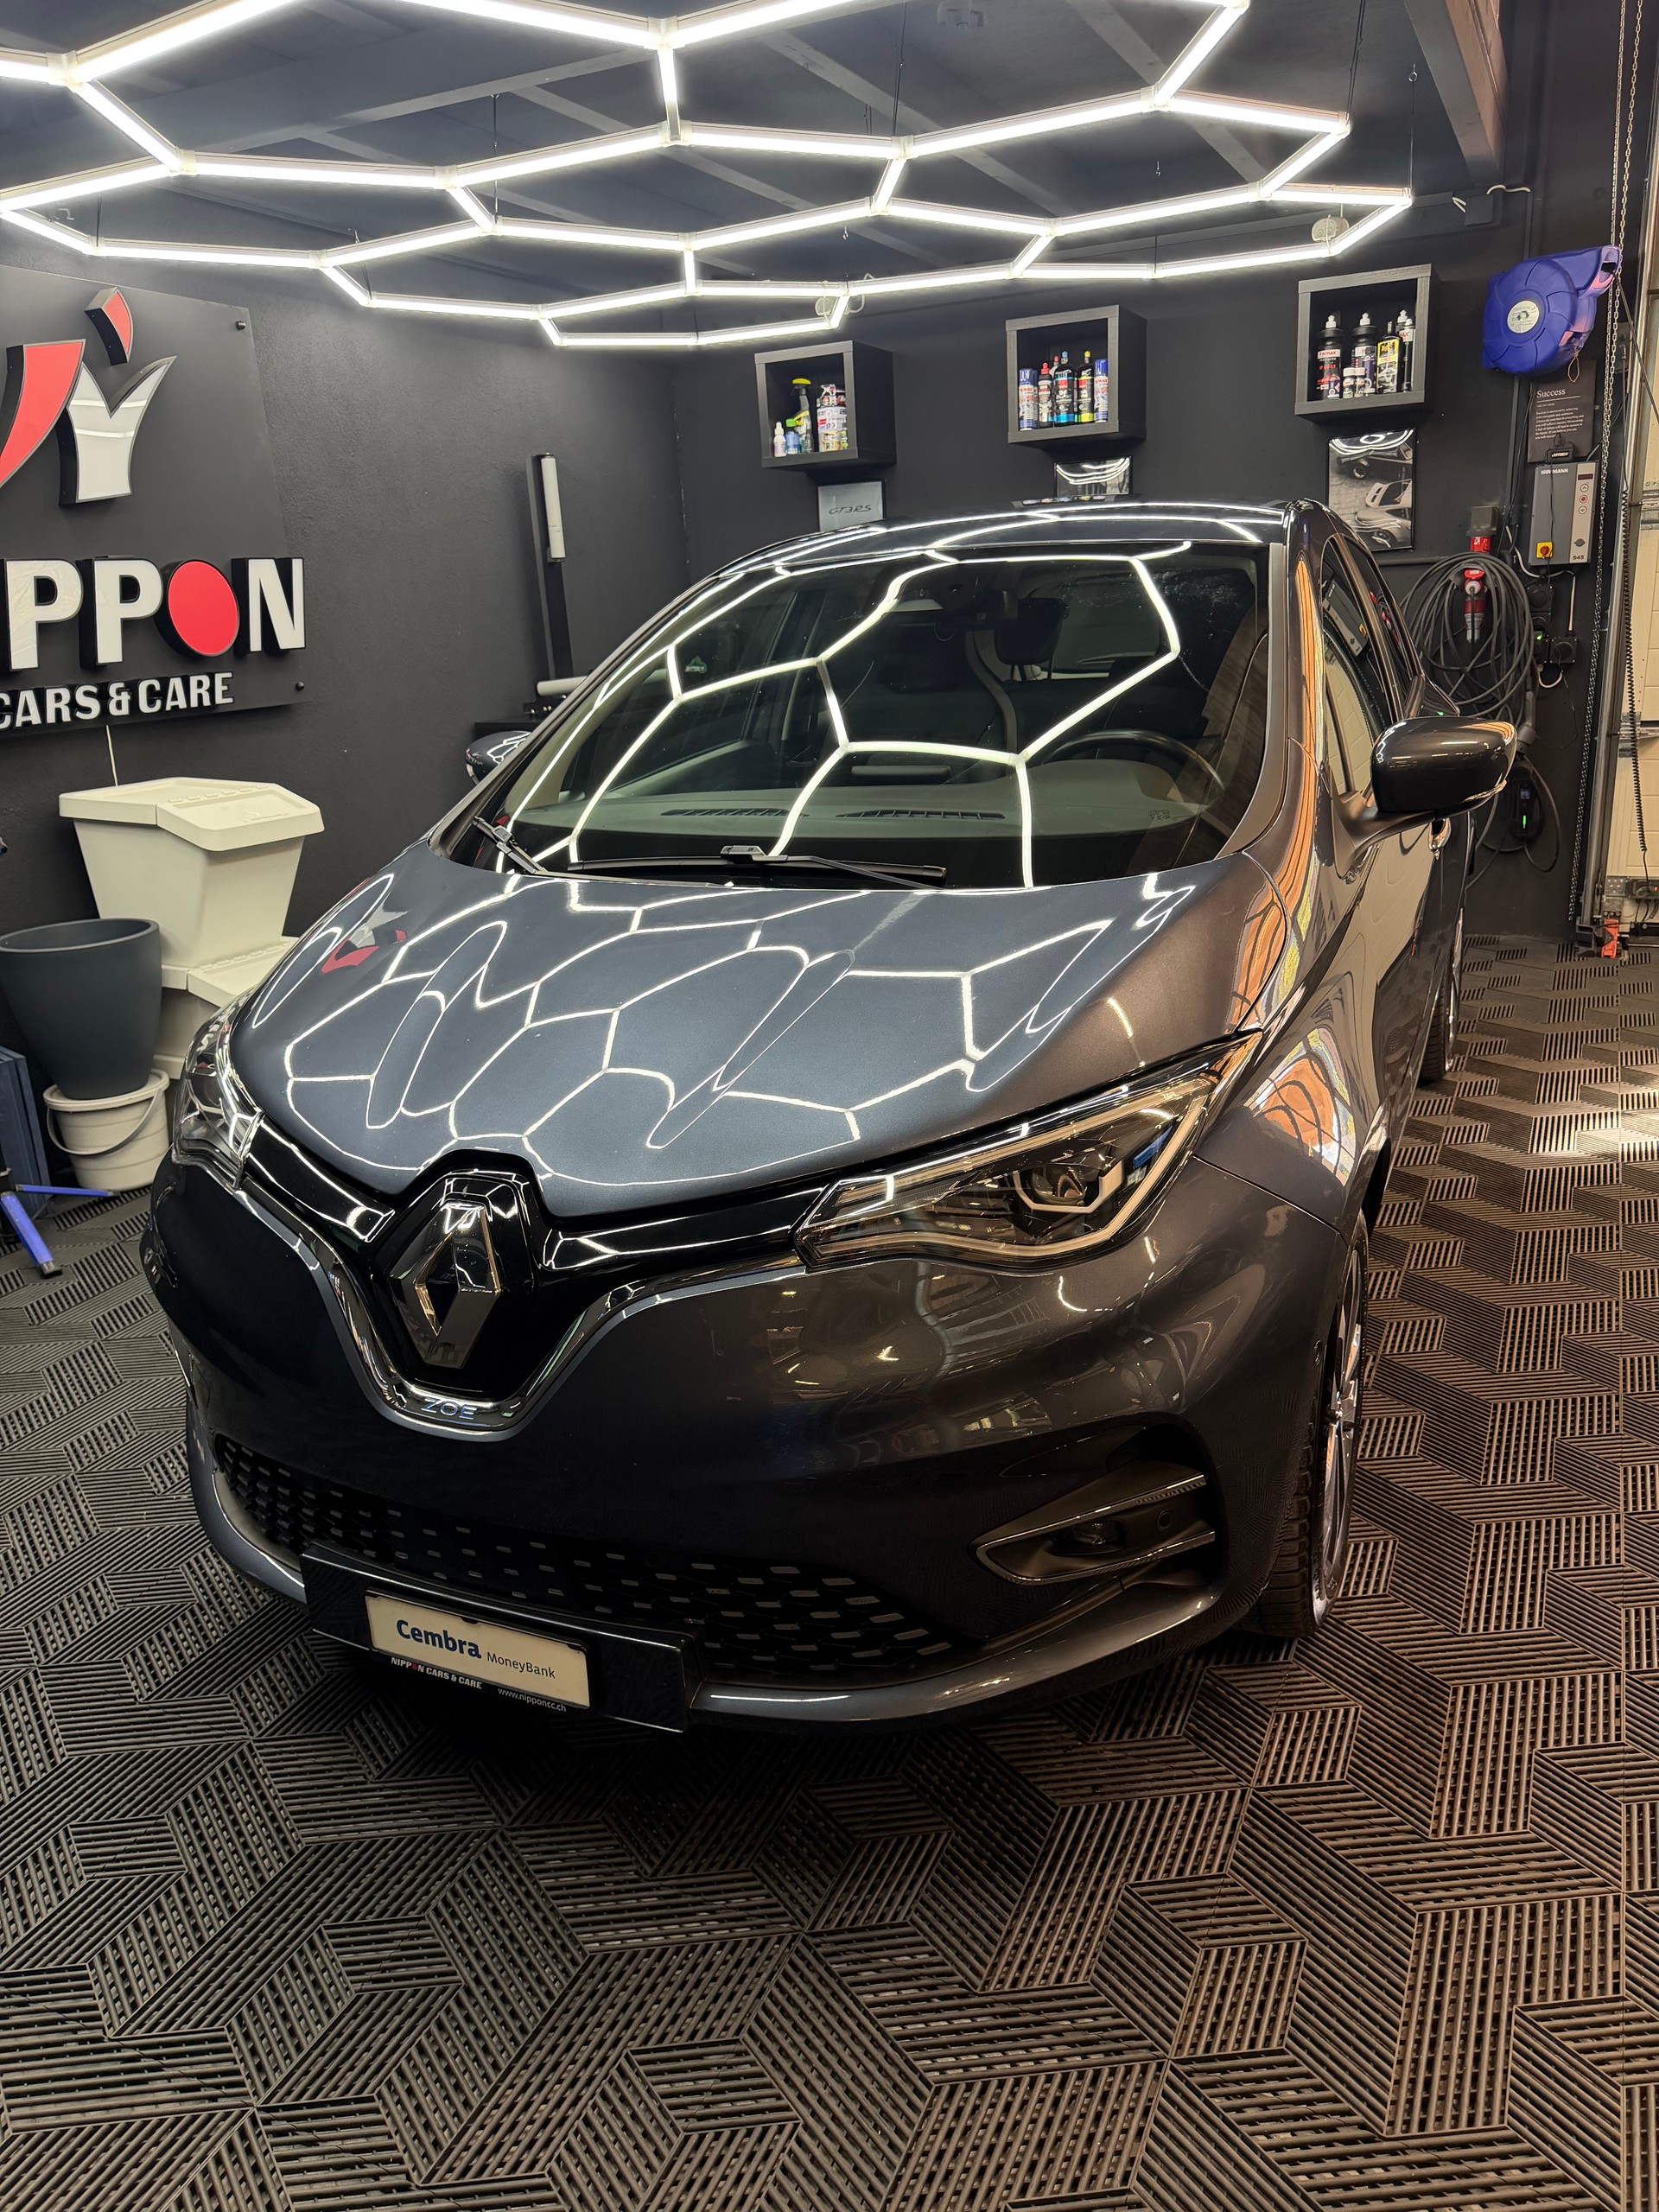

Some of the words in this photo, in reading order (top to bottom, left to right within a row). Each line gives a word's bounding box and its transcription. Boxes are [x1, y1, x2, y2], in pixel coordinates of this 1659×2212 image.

[1536, 389, 1566, 398] Success
[108, 682, 130, 717] &
[137, 671, 234, 715] CARE
[421, 1397, 478, 1420] ZOE
[397, 1619, 482, 1659] Cembra
[486, 1651, 556, 1679] MoneyBank
[391, 1656, 424, 1673] NIPPON
[426, 1667, 449, 1681] CARS
[458, 1676, 482, 1689] CARE
[498, 1688, 567, 1713] www.nipponcc.ch
